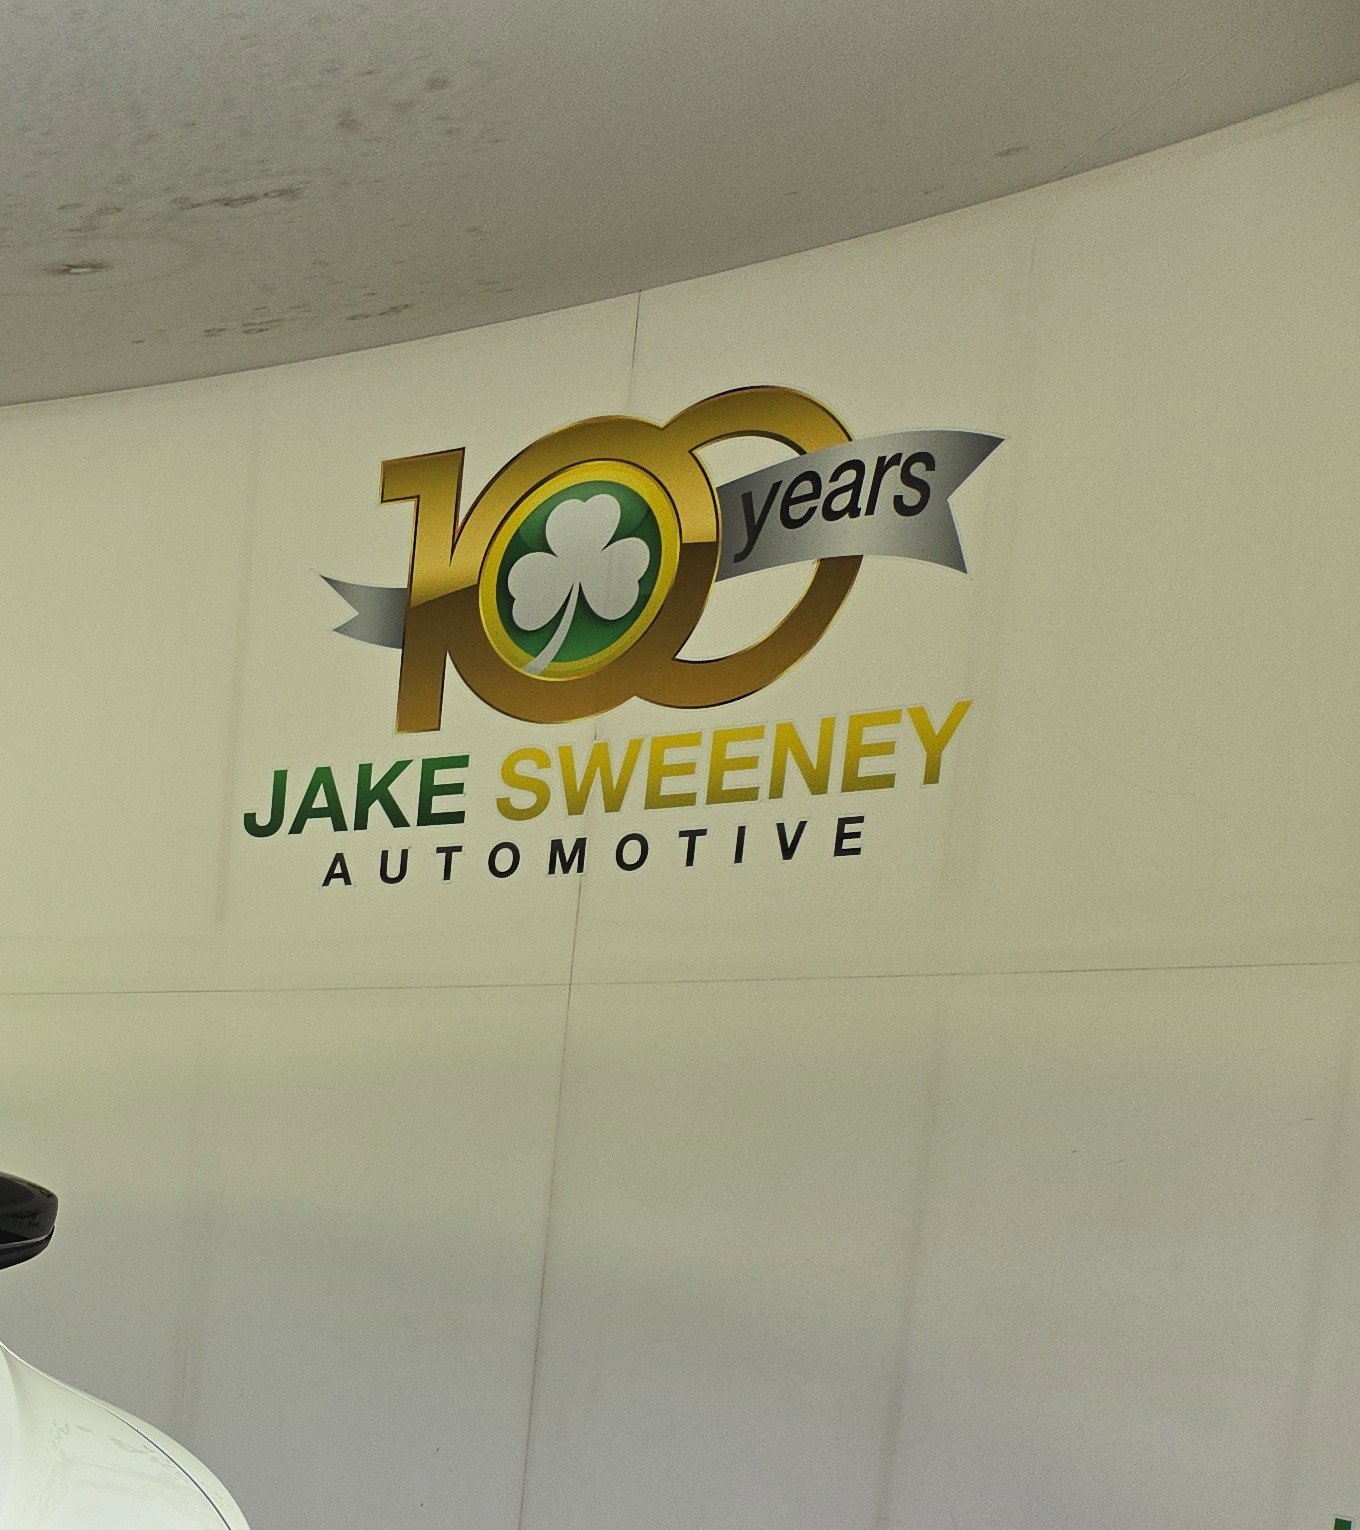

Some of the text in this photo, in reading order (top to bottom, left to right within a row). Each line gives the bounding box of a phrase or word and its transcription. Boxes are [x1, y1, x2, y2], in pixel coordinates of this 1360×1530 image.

[379, 384, 937, 734] 100 years
[243, 699, 973, 839] JAKE SWEENEY
[322, 815, 865, 888] AUTOMOTIVE
